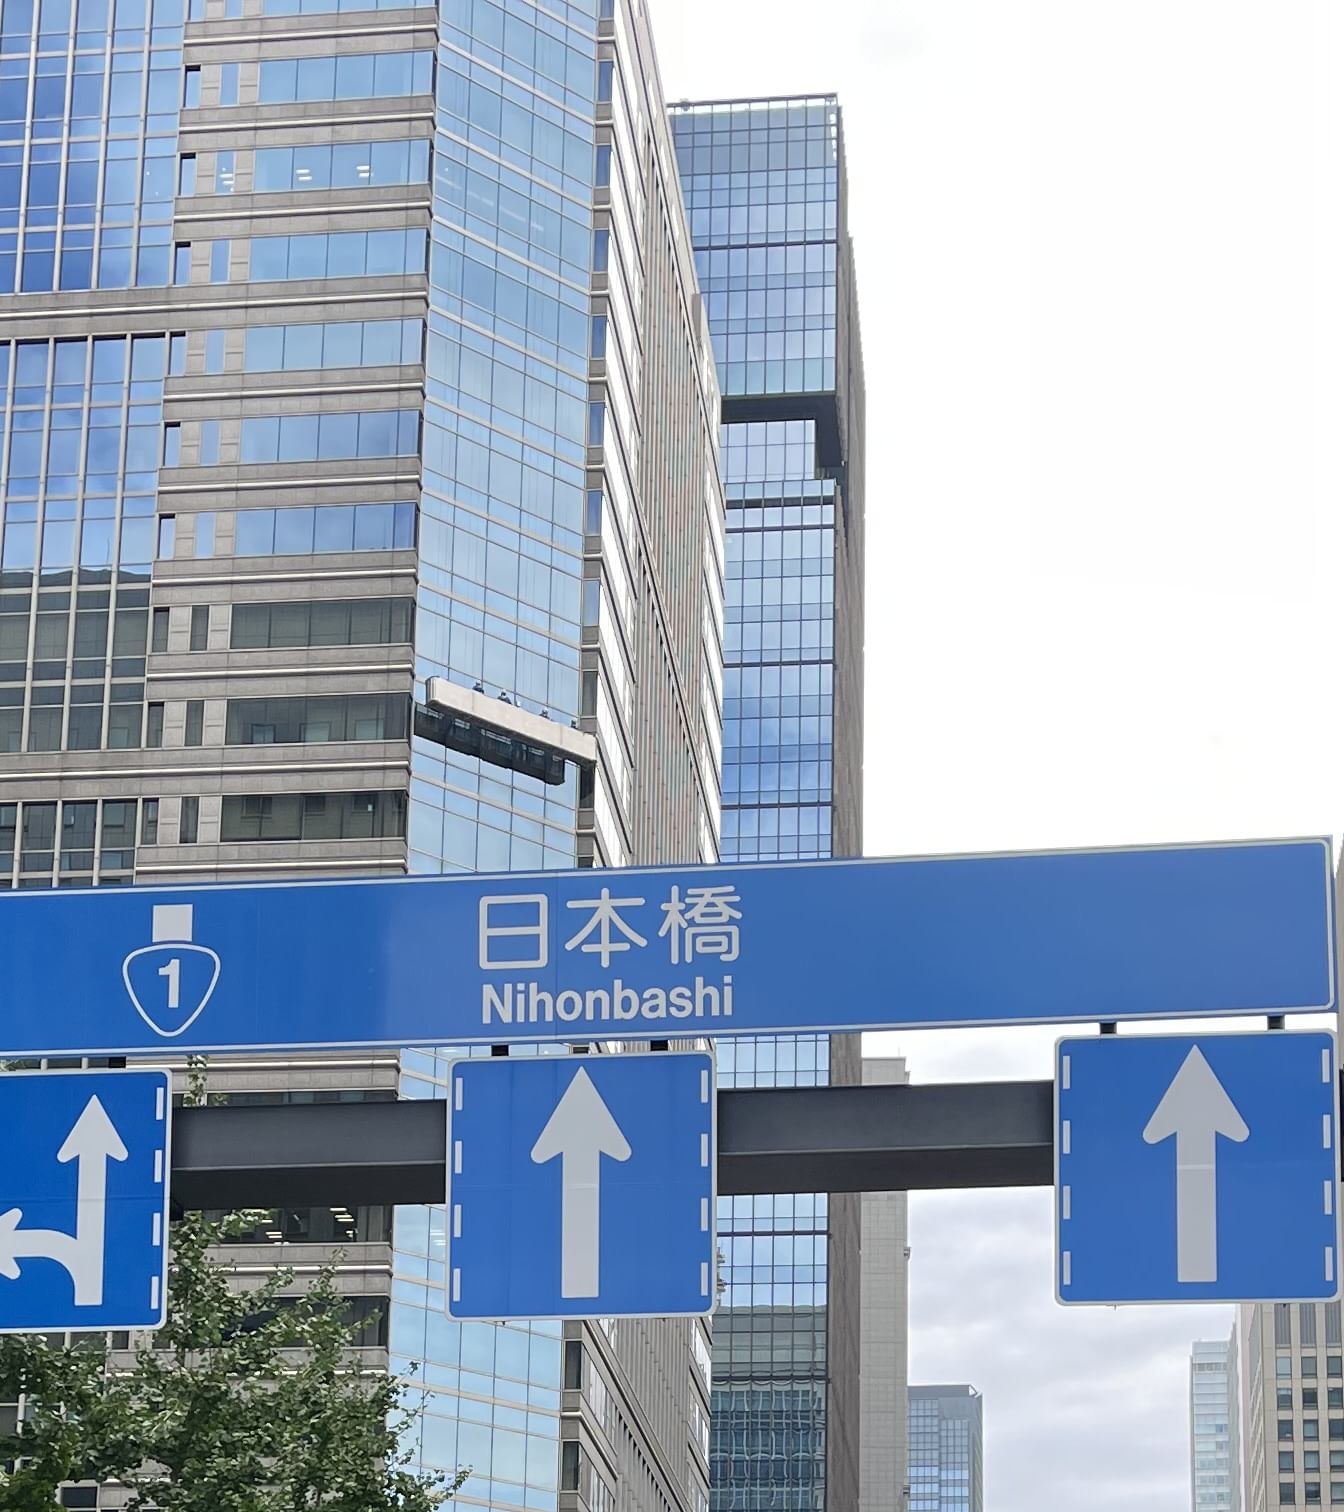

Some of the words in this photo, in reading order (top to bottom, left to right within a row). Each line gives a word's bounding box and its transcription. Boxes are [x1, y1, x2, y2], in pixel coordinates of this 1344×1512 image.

[478, 884, 743, 970] 日本橋
[158, 957, 181, 1009] 1
[482, 975, 734, 1025] Nihonbashi
